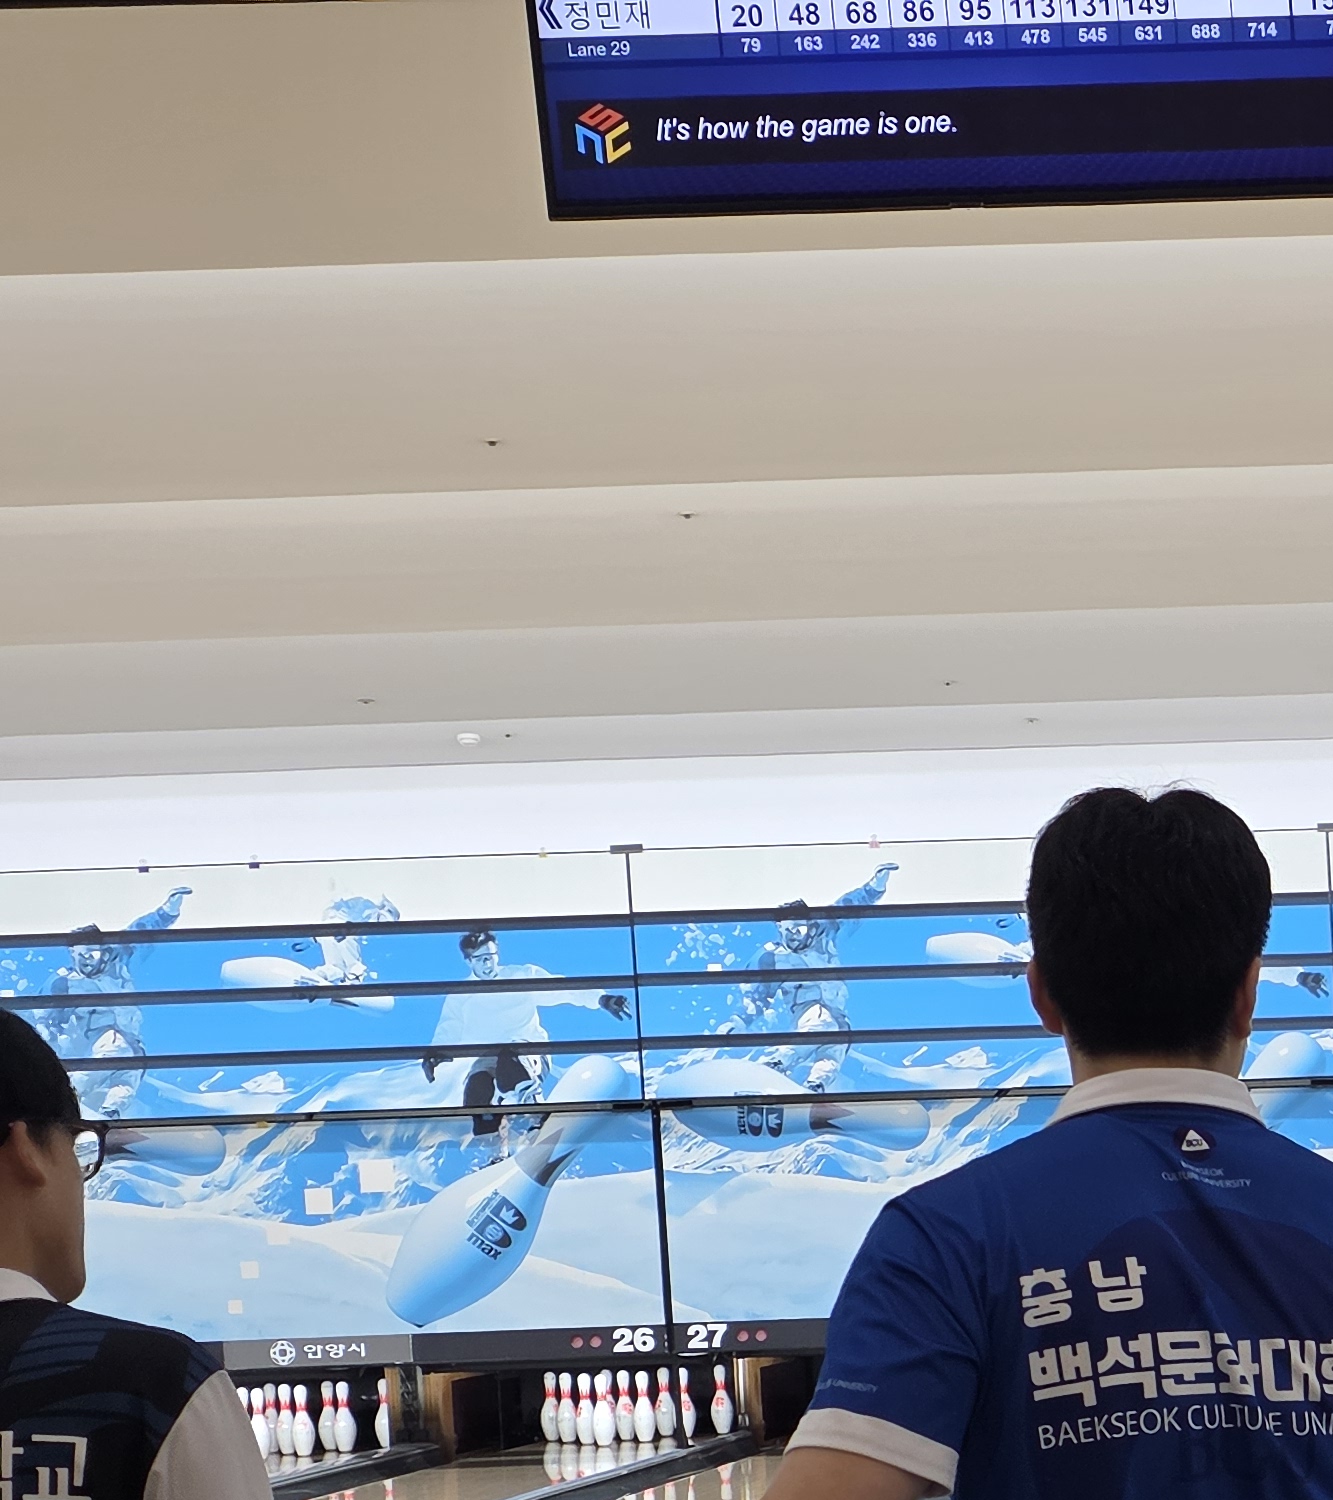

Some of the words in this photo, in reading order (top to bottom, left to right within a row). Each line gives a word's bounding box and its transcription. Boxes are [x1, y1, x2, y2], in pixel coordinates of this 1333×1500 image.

[564, 0, 651, 31] 정민재
[731, 4, 764, 28] 20
[789, 2, 821, 26] 48
[846, 0, 878, 24] 68
[903, 0, 935, 23] 86
[960, 0, 992, 20] 95
[567, 42, 607, 58] Lane
[610, 41, 631, 56] 29
[741, 38, 762, 53] 79
[793, 36, 823, 52] 163
[850, 34, 881, 50] 242
[907, 33, 938, 48] 336
[964, 31, 994, 47] 413
[1021, 29, 1051, 45] 478
[1078, 27, 1107, 43] 545
[1134, 26, 1163, 42] 631
[1191, 24, 1221, 39] 688
[1248, 22, 1278, 38] 714
[656, 117, 691, 142] It's
[697, 116, 749, 140] how
[756, 115, 795, 139] the
[801, 115, 871, 143] game
[878, 111, 899, 135] is
[904, 113, 958, 136] one.
[466, 1232, 502, 1260] max
[304, 1341, 367, 1360] 안양시
[612, 1328, 656, 1353] 26
[686, 1324, 729, 1349] 27
[1037, 1407, 1182, 1450] BAEKSEOK
